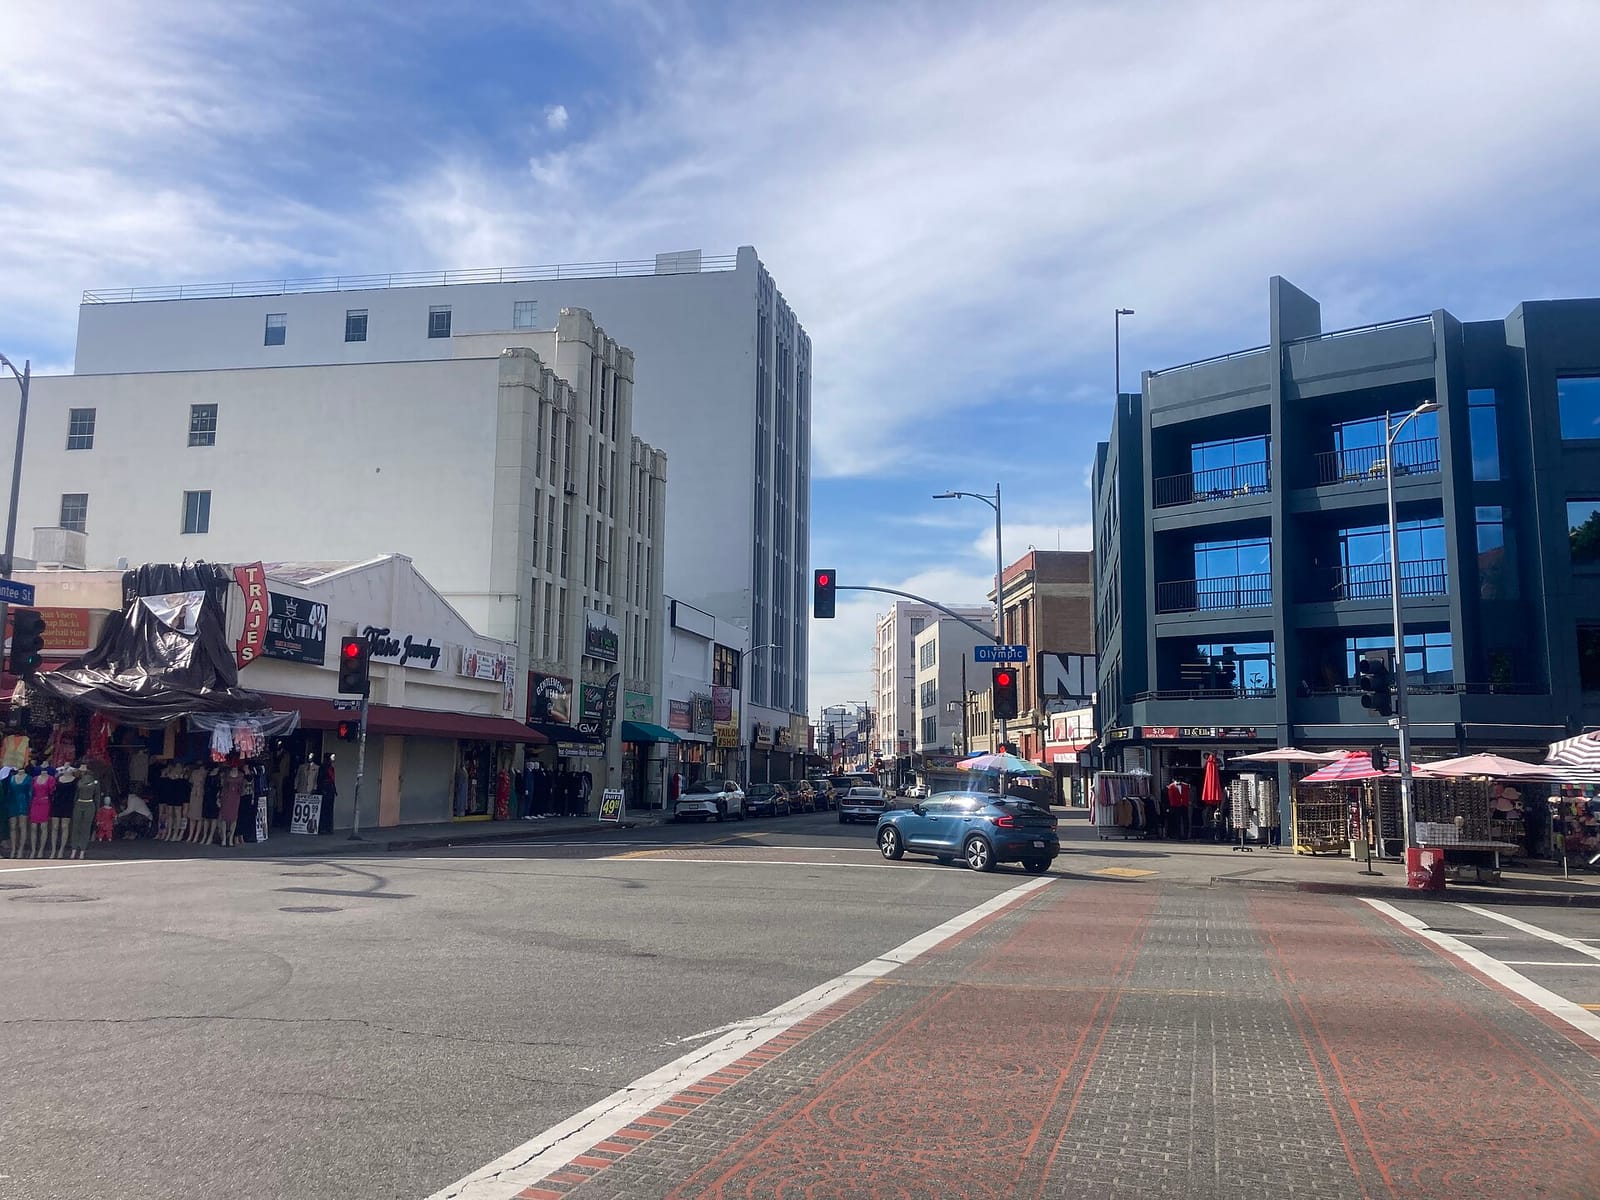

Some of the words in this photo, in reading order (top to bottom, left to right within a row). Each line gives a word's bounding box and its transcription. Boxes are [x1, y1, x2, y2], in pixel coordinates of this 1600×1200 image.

[22, 589, 32, 601] St
[241, 568, 263, 660] TRAJES
[979, 648, 1023, 660] Olympic
[579, 723, 599, 733] GW
[717, 728, 738, 737] TAILO
[603, 800, 615, 815] 49
[294, 804, 311, 824] 99
